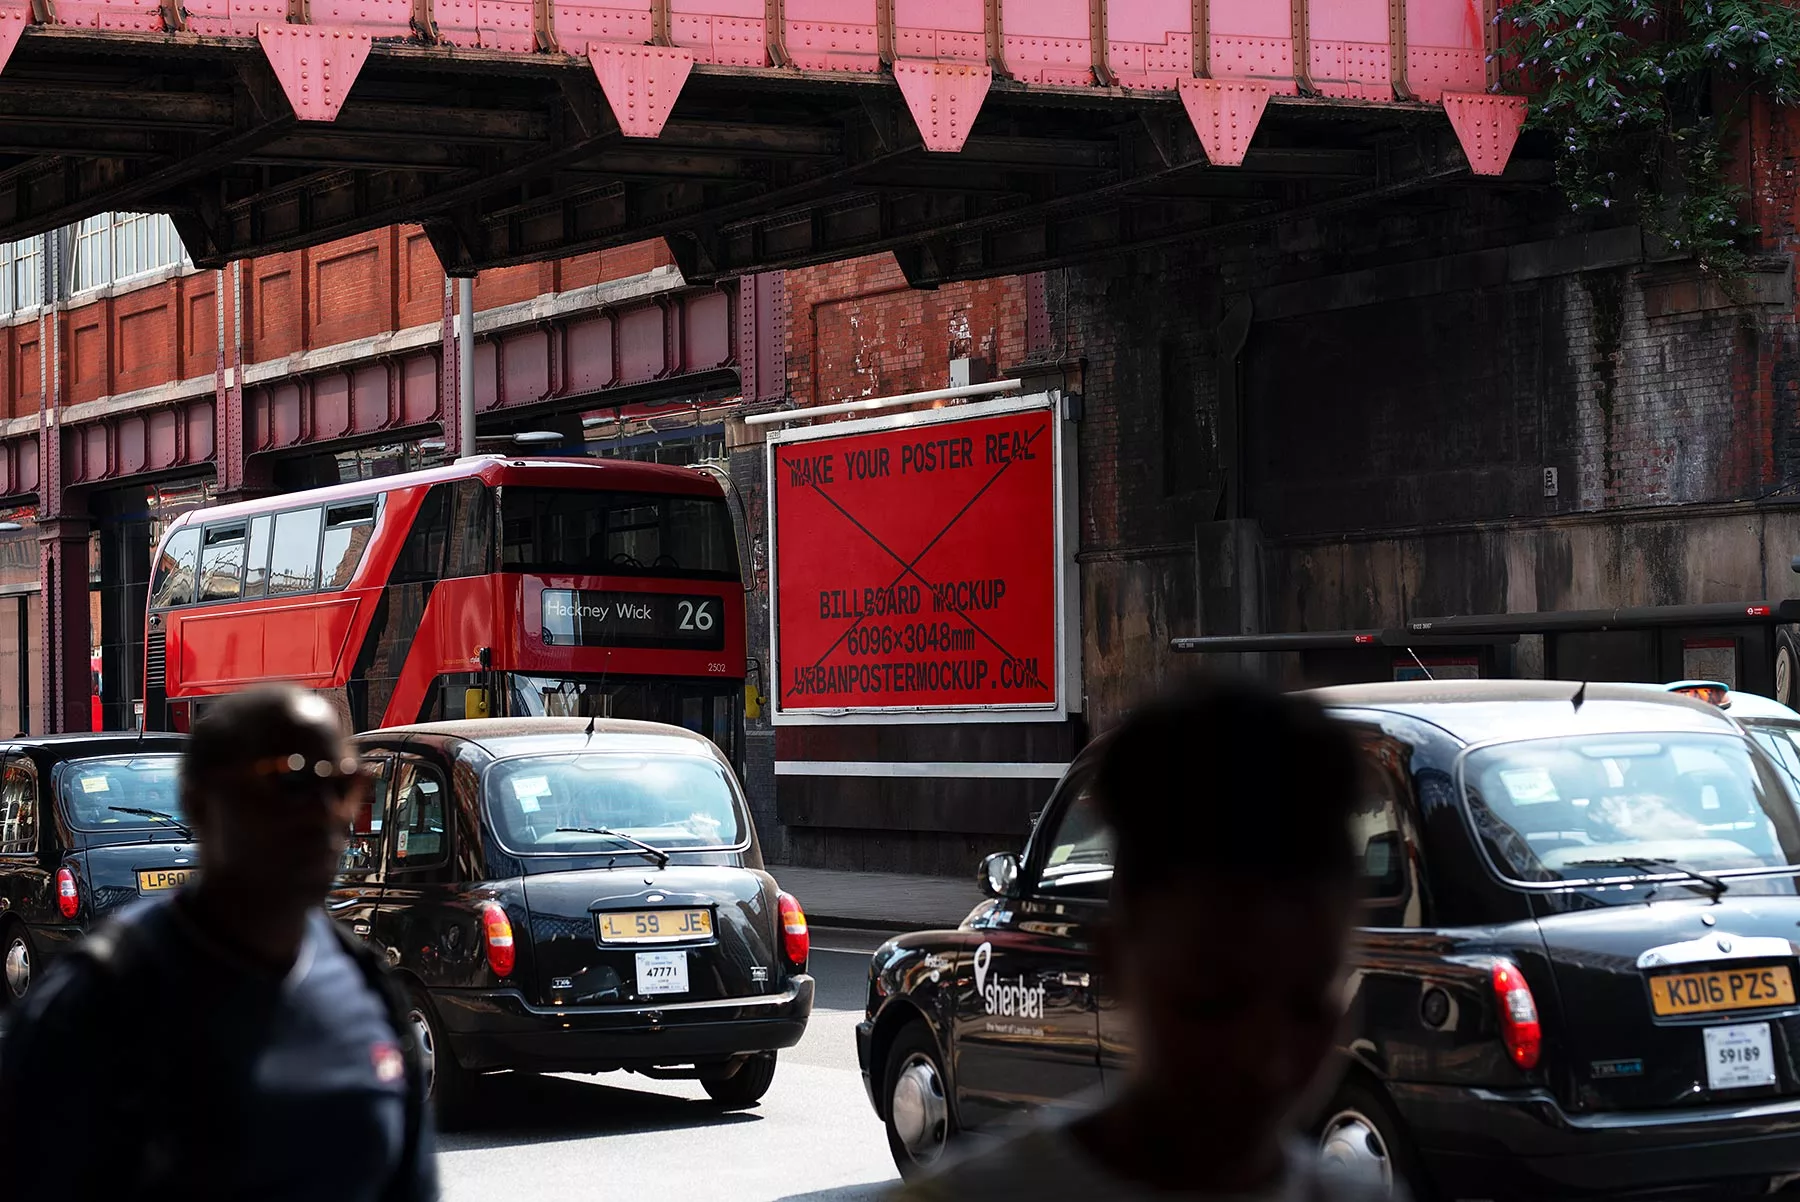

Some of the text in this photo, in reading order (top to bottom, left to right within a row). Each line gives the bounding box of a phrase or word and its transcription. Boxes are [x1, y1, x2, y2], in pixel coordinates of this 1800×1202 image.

[790, 430, 1036, 487] MAKE YOUR POSTER REAL
[547, 600, 652, 621] Hackney Wick
[819, 579, 1006, 619] BILLBOARD MOCKUP
[678, 600, 714, 631] 26
[708, 663, 726, 672] 2502
[793, 659, 1038, 694] URBANPOSTERMOCKUP.COM
[635, 915, 659, 933] 59
[679, 913, 702, 932] JE
[646, 967, 677, 977] 47771
[985, 972, 1046, 1019] sherbet
[1666, 972, 1778, 1007] KD16 PZS
[1719, 1046, 1760, 1064] 59189
